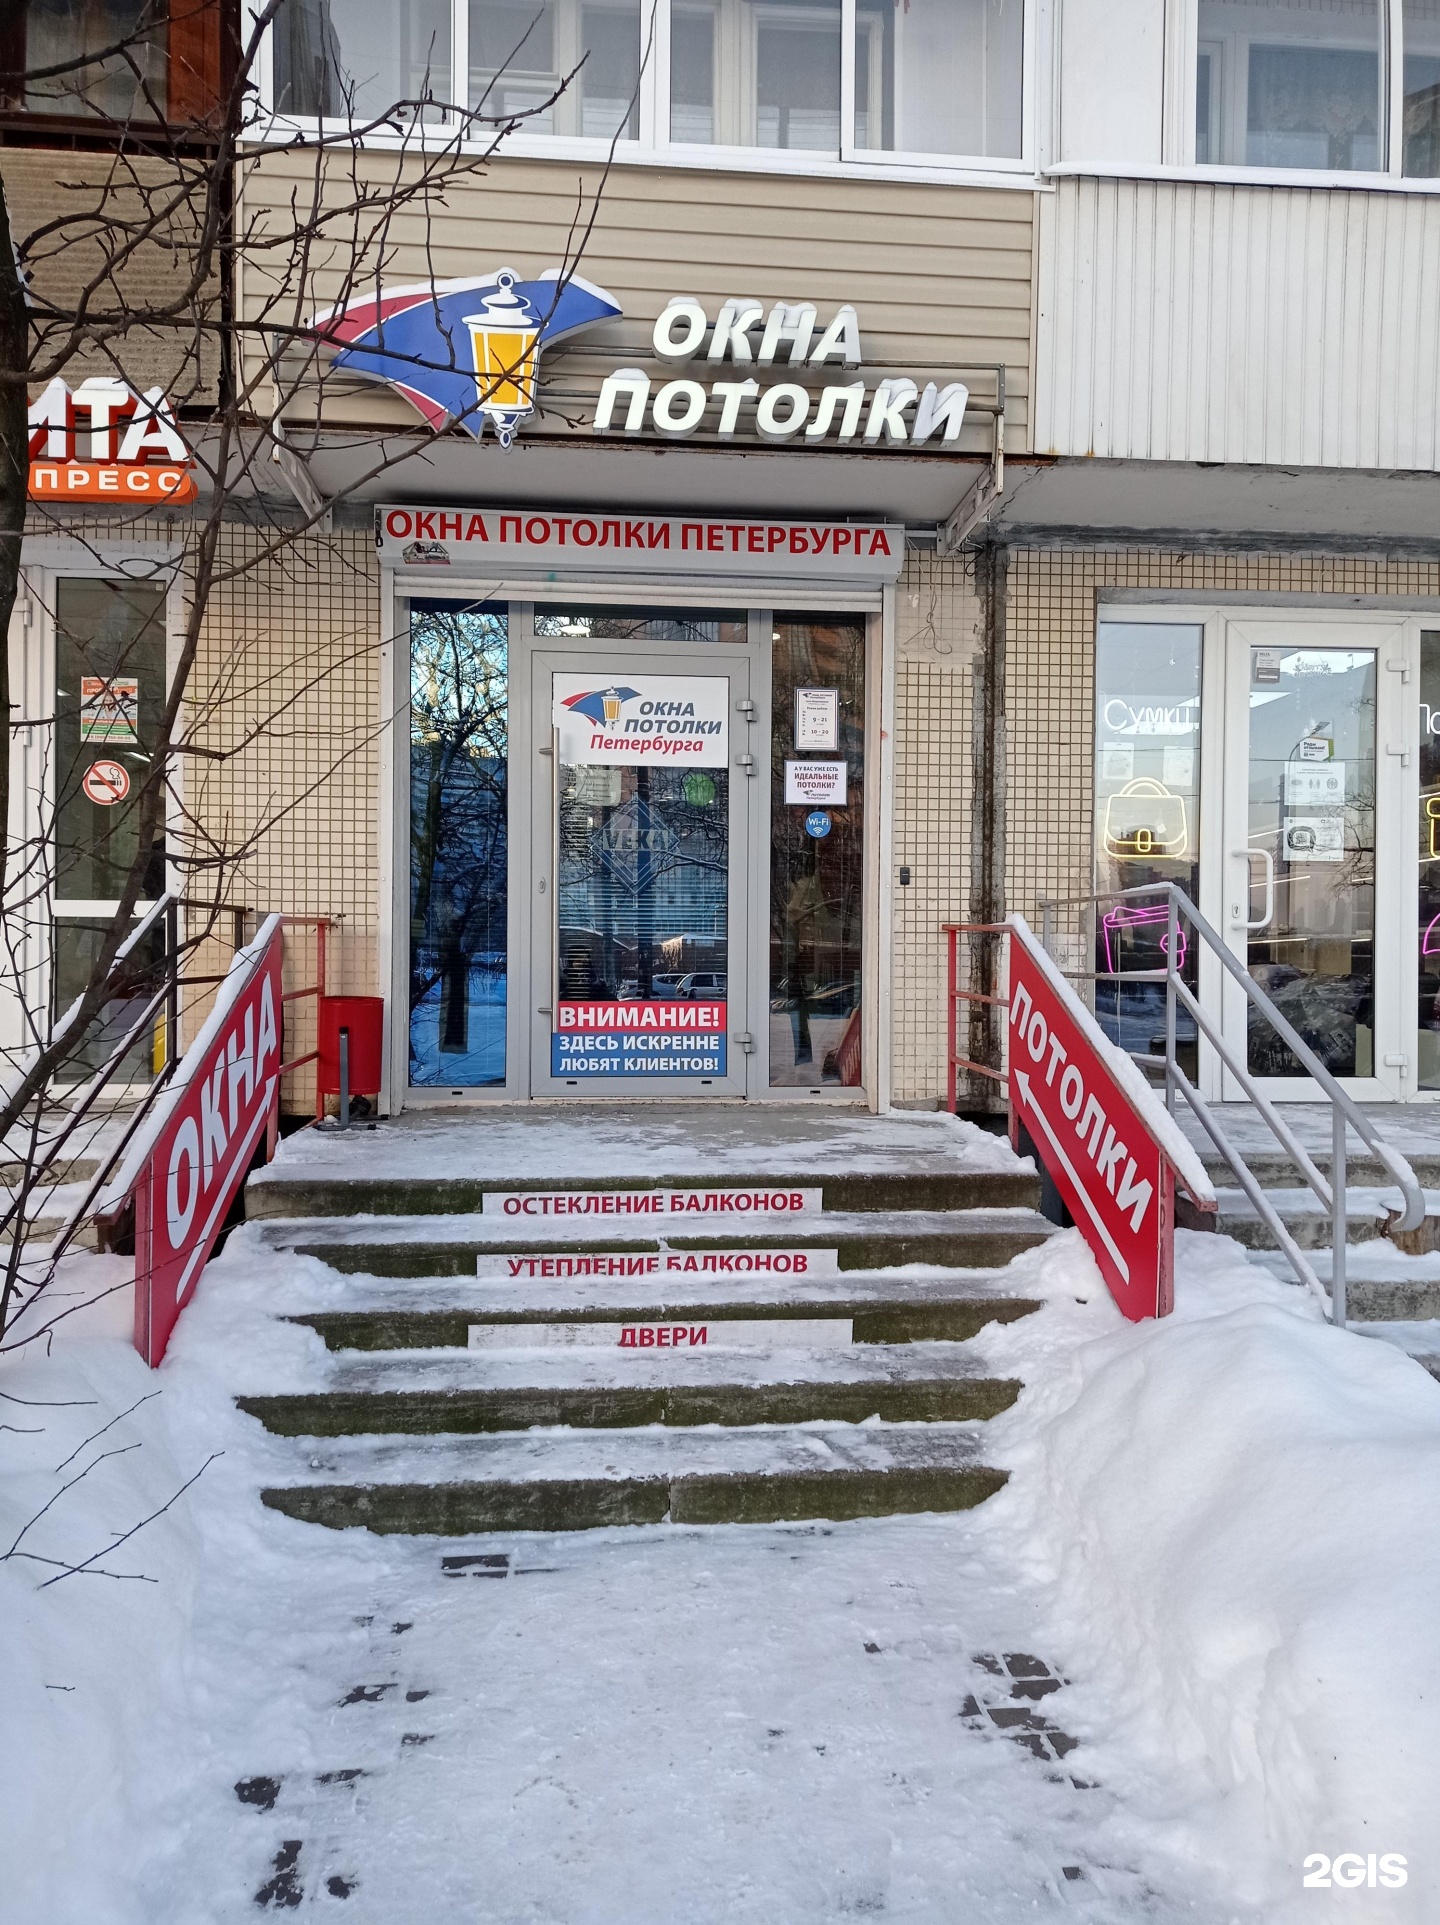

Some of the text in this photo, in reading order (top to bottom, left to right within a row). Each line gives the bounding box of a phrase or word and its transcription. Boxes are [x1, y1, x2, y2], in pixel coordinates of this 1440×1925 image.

[652, 300, 862, 370] ОКНА
[593, 378, 969, 446] ПОТОЛКИ
[386, 509, 892, 556] ОКНА ПОТОЛКИ ПЕТЕРБУРГА
[639, 701, 695, 717] ОКНА
[624, 719, 722, 735] ПОТОЛКИ
[590, 734, 704, 755] Петербурга
[797, 781, 836, 789] ПОТОЛКИ?
[808, 817, 829, 826] Wi-Fi
[604, 829, 668, 850] VEKA
[559, 1006, 720, 1028] ВНИМАНИЕ!
[559, 1035, 720, 1053] ЗДЕСЬ ИСКРЕННЕ
[559, 1057, 719, 1071] ЛЮБЯТ КЛИЕНТОВ!
[167, 970, 278, 1250] ОКНА
[1009, 980, 1154, 1234] ПОТОЛКИ
[503, 1192, 804, 1215] ОСТЕКЛЕНИЕ БАЛКОНОВ
[507, 1253, 808, 1278] УТЕПЛЕНИЕ БАЛКОНОВ
[617, 1326, 708, 1349] ДВЕРИ
